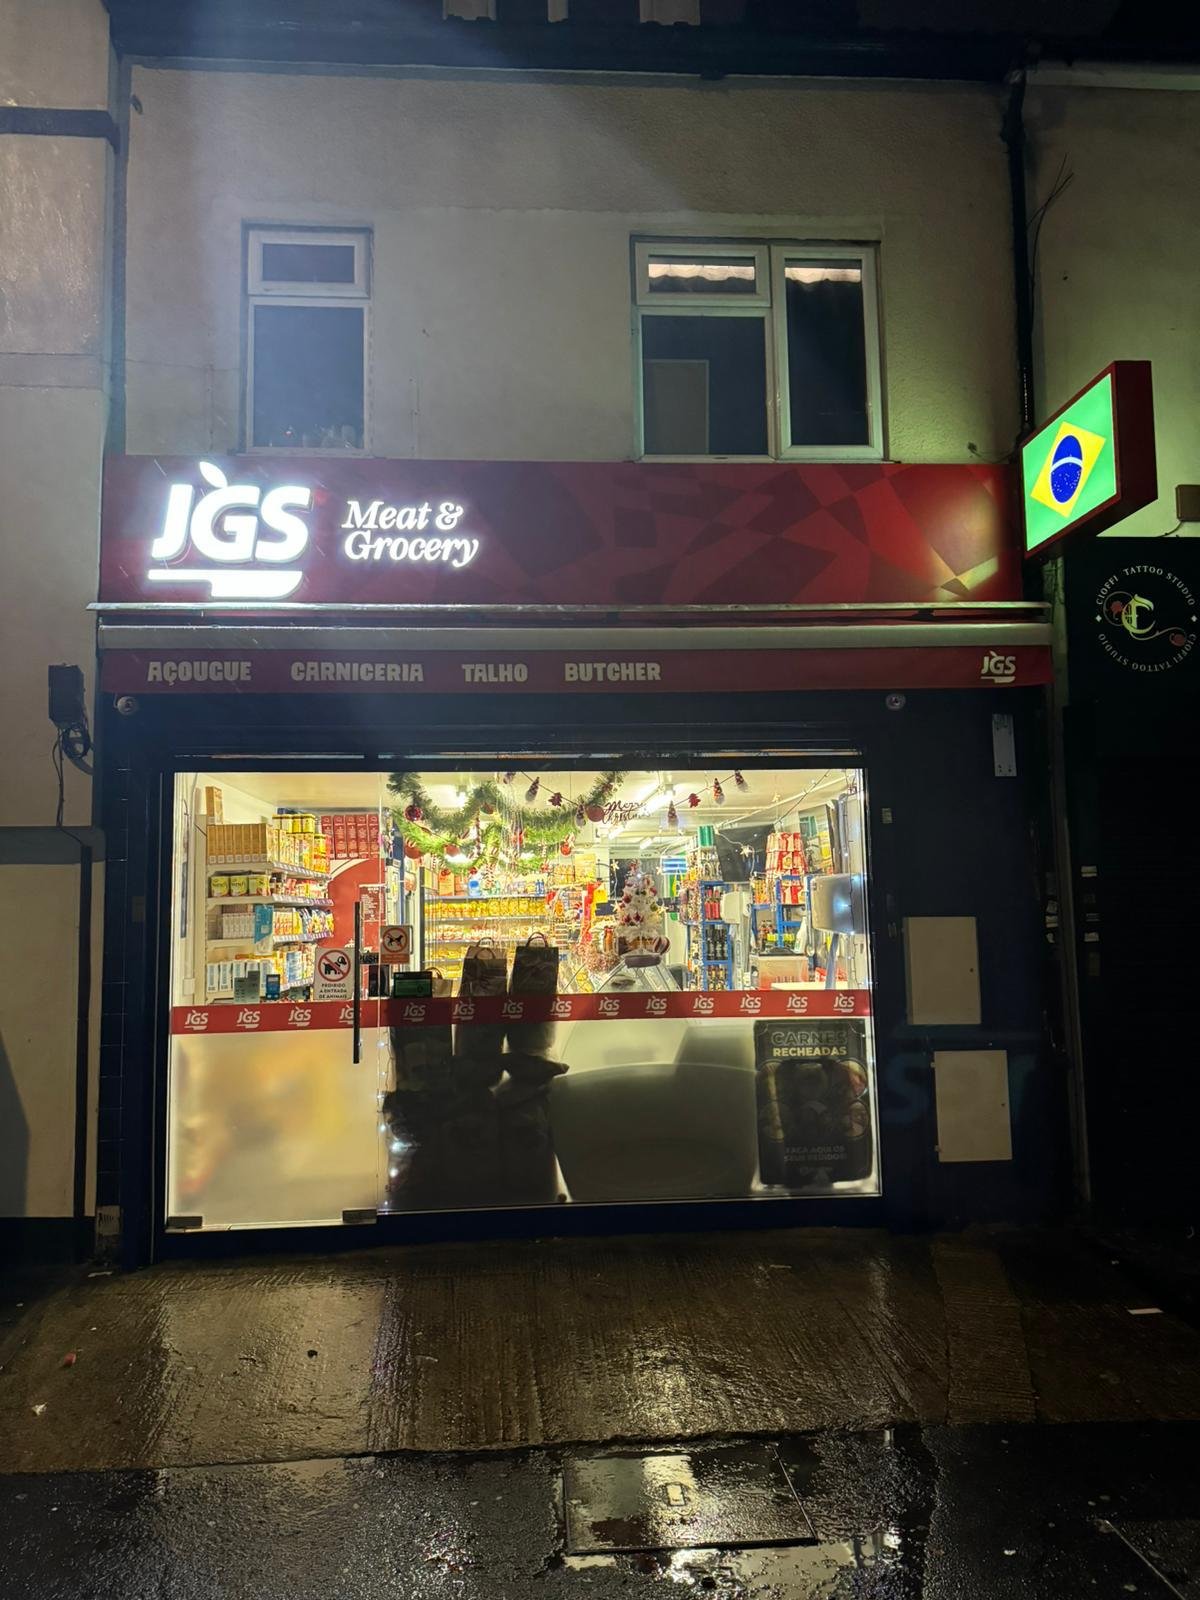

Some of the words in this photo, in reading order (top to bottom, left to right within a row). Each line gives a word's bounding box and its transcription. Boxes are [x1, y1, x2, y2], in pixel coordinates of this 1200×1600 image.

[151, 462, 312, 563] JGS
[341, 500, 431, 530] Meat
[436, 501, 464, 530] &
[344, 529, 480, 568] Grocery
[1095, 575, 1119, 605] CIOFFI
[1122, 565, 1164, 576] TATTOO
[1165, 572, 1196, 606] STUDIO
[1098, 633, 1129, 666] STUDIO
[1173, 633, 1197, 663] CIOFFI
[981, 650, 1016, 675] JGS
[1131, 661, 1173, 672] TATTOO
[147, 661, 252, 686] AÇOUGUE
[290, 662, 425, 682] CARNICERIA
[461, 663, 528, 682] TALHO
[564, 662, 661, 681] BUTCHER
[453, 1001, 475, 1015] JGS
[502, 1000, 524, 1014] JGS
[550, 998, 572, 1012] JGS
[598, 997, 620, 1011] JGS
[645, 996, 667, 1010] JGS
[693, 995, 715, 1009] JGS
[740, 994, 762, 1008] JGS
[787, 994, 809, 1008] JGS
[834, 994, 856, 1008] JGS
[236, 1008, 261, 1023] JGS
[288, 1006, 312, 1021] JGS
[403, 1002, 426, 1017] JGS
[184, 1010, 209, 1025] JGS
[771, 1030, 848, 1046] CARNES
[773, 1046, 848, 1057] RECHEADAS
